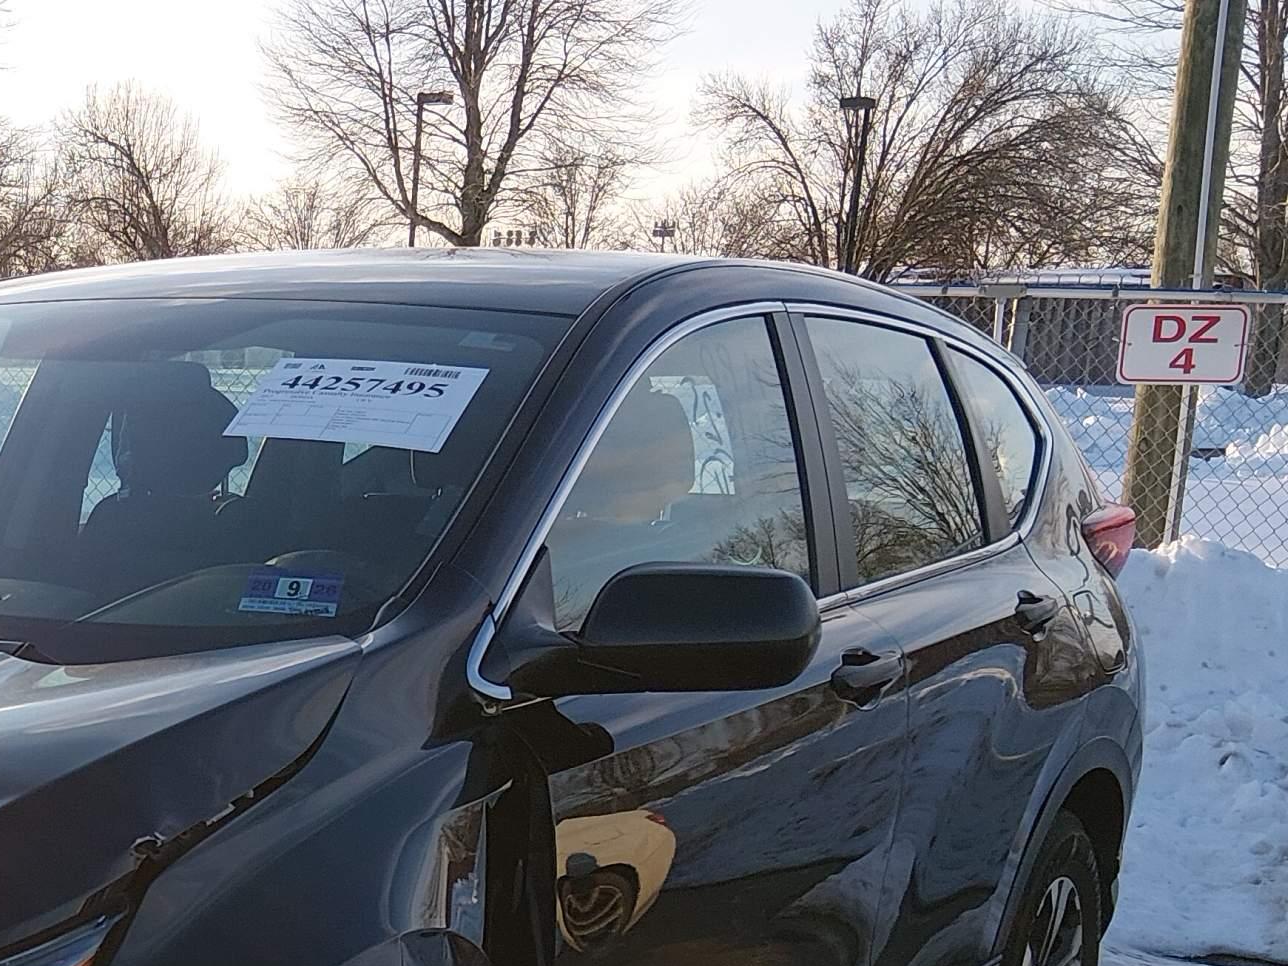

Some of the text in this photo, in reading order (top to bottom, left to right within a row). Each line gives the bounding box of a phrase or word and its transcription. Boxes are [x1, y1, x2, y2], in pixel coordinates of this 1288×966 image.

[1151, 315, 1221, 343] DZ
[1168, 348, 1196, 374] 4
[280, 375, 449, 398] 44257495
[286, 580, 301, 597] 9
